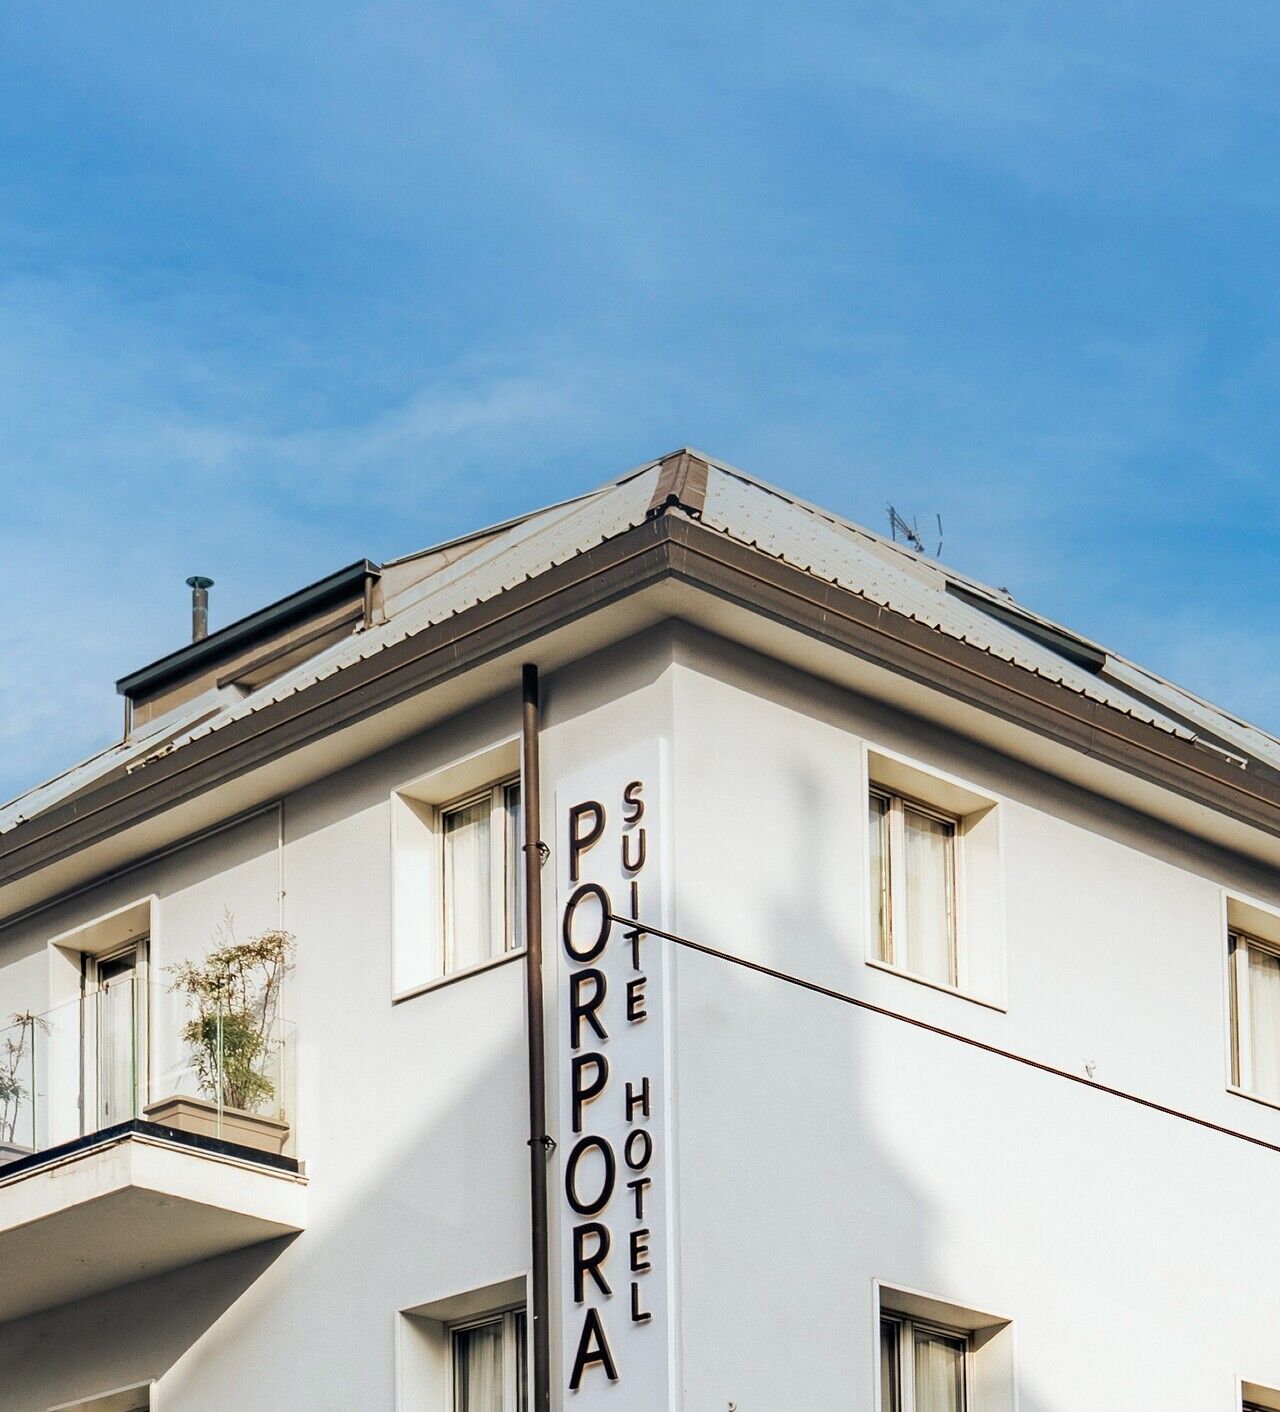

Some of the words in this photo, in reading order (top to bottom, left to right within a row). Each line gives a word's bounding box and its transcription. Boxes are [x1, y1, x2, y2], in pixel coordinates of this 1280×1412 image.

[622, 779, 648, 1026] SUITE
[562, 800, 619, 1392] PORPORA
[624, 1075, 652, 1324] HOTEL
